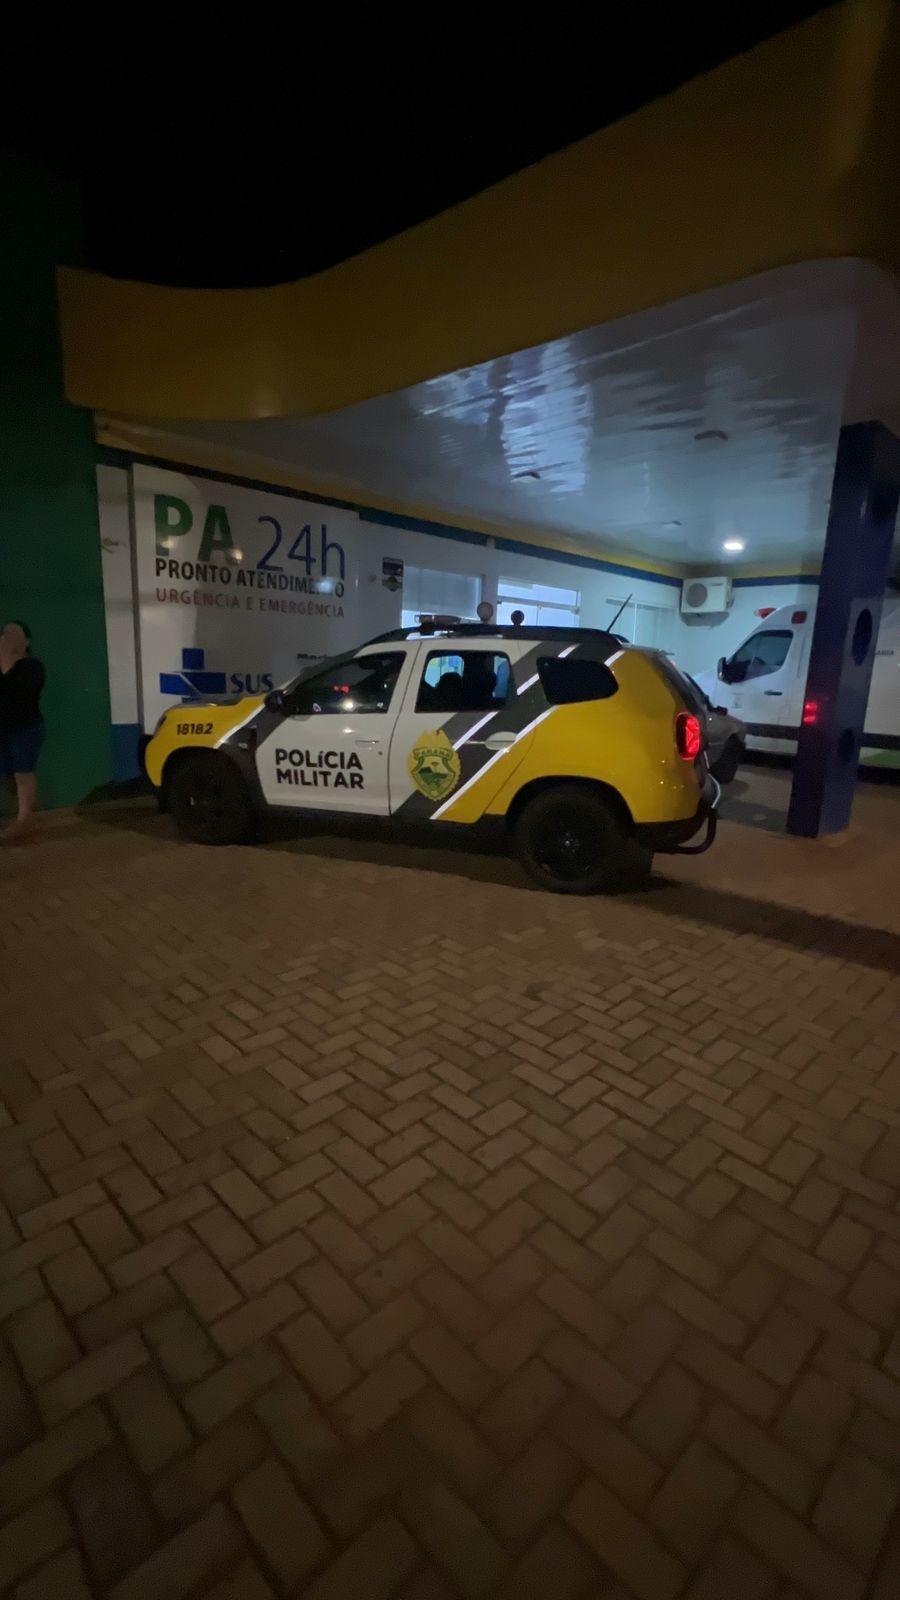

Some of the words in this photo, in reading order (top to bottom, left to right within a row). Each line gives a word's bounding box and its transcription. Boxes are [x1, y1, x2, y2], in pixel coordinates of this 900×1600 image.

[154, 494, 236, 562] PA
[258, 515, 345, 580] 24h
[155, 558, 232, 584] PRONTO
[236, 569, 345, 598] ATENDIMEO
[246, 596, 253, 610] E
[231, 672, 274, 694] SUS
[176, 722, 213, 735] 18182
[276, 767, 364, 789] MILITAR
